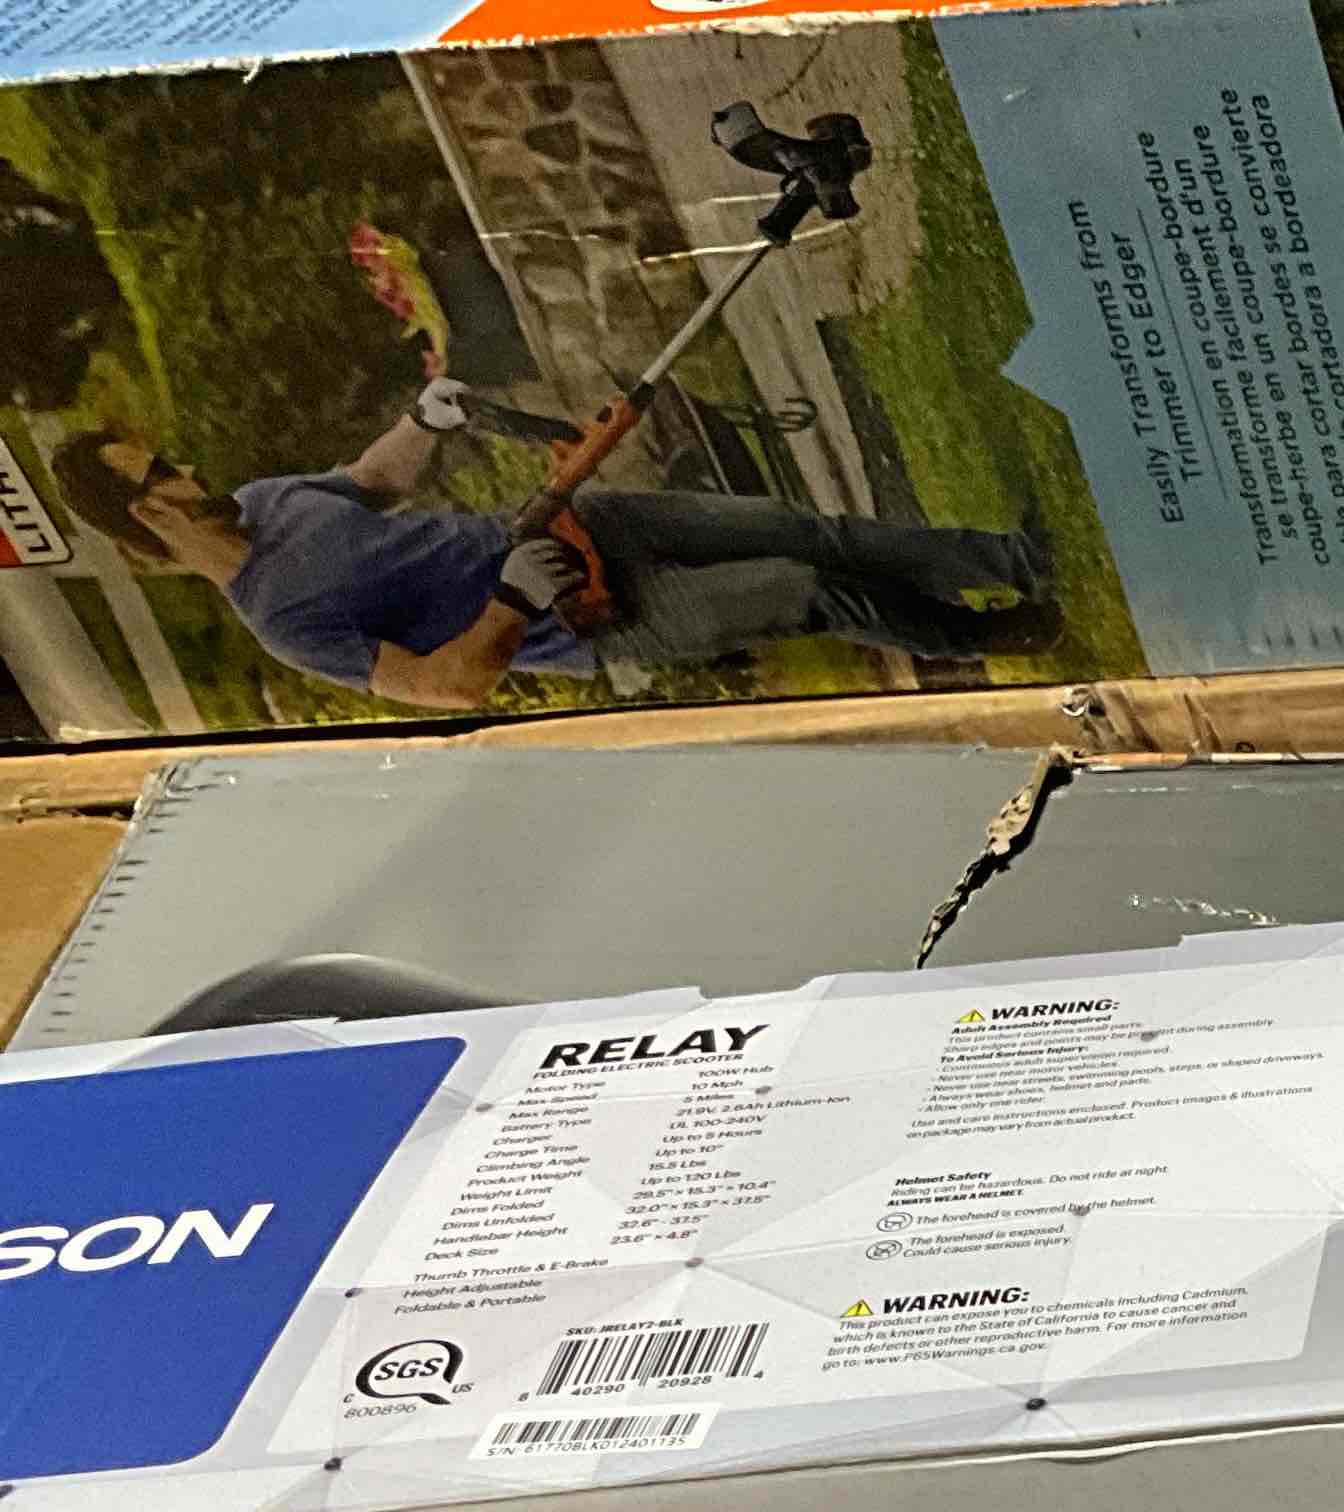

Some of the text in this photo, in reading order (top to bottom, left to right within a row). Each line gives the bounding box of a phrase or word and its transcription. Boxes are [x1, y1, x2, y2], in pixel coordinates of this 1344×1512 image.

[1220, 88, 1271, 217] convierte
[1251, 94, 1310, 254] bordeadora
[1259, 225, 1282, 254] se
[1298, 262, 1316, 277] a
[1191, 224, 1248, 362] facilement
[1269, 262, 1309, 354] bordes
[1067, 200, 1185, 523] Easily Transforms from
[1110, 231, 1203, 483] Trimmer to Edger
[1137, 131, 1278, 566] Transformation en coupe-bordure
[1192, 124, 1331, 566] coupe-herbe en un coupe-bordure
[1296, 360, 1331, 437] cortar
[1236, 370, 1289, 505] transforme
[1277, 513, 1298, 539] se
[539, 1023, 771, 1070] RELAY
[991, 999, 1121, 1021] WARNING:
[532, 1053, 744, 1079] FOLDING ELECTRIC SCOOTER
[882, 1287, 1030, 1315] WARNING:
[374, 1358, 443, 1381] SGS
[570, 1375, 713, 1397] 40290 20928
